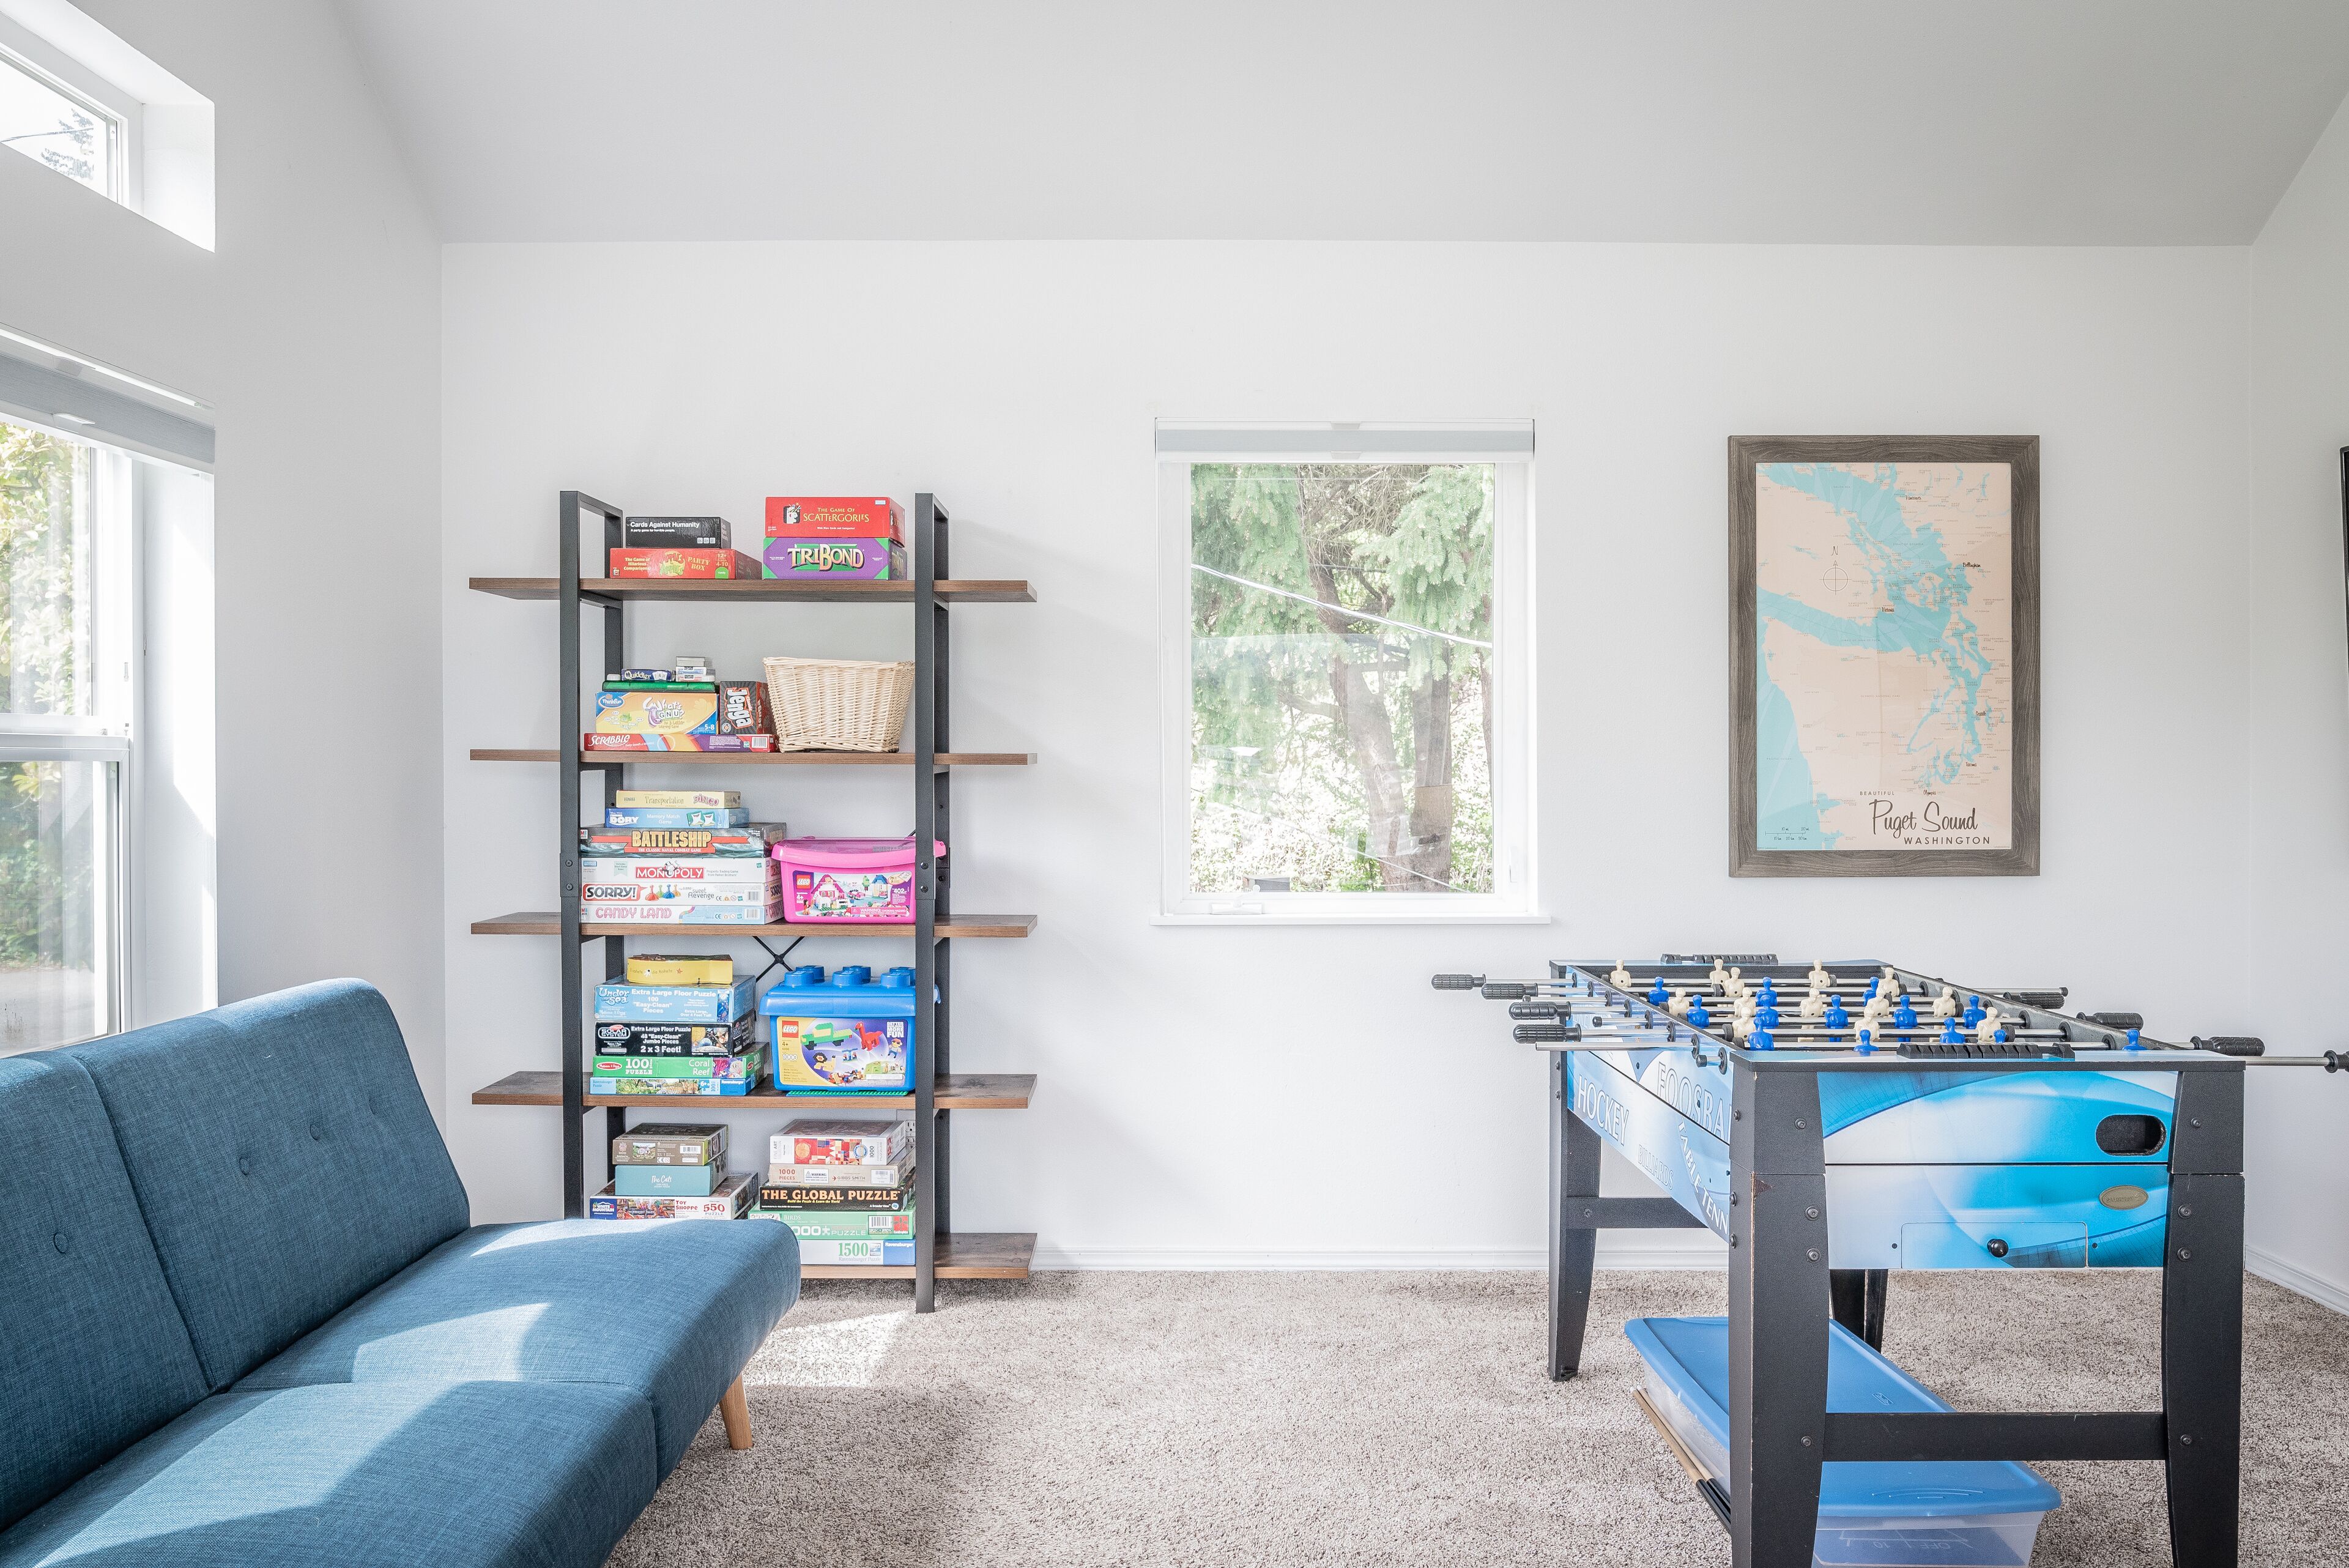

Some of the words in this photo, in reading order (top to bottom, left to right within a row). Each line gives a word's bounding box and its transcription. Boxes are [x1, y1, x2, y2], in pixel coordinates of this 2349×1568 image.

[803, 513, 870, 522] SCATTERGORIES
[1831, 546, 1839, 555] N
[688, 557, 710, 565] PARTY
[787, 543, 865, 571] TRIBOND
[624, 671, 651, 680] Quiddler
[727, 689, 752, 727] Jenga
[659, 710, 685, 719] GNU?
[588, 735, 630, 746] SCRABBLE
[645, 796, 684, 805] Transportation
[1869, 799, 1917, 839] Puget
[1921, 801, 1978, 832] Sound
[632, 830, 712, 848] BATTLESHIP
[637, 868, 703, 879] MONOPOLY
[587, 886, 636, 898] SORRY!
[596, 907, 637, 918] CANDY
[640, 907, 672, 918] LAND
[598, 987, 629, 997] Under
[783, 1025, 798, 1034] LEGO
[625, 1058, 650, 1069] 100
[1577, 1074, 1630, 1147] HOCKEY
[1679, 1118, 1702, 1194] TABLE
[1638, 1144, 1674, 1191] BILLIARDS
[762, 1190, 787, 1200] THE
[792, 1190, 844, 1200] GLOBAL
[703, 1203, 725, 1212] 550
[791, 1225, 822, 1236] 000
[838, 1243, 869, 1257] 1500
